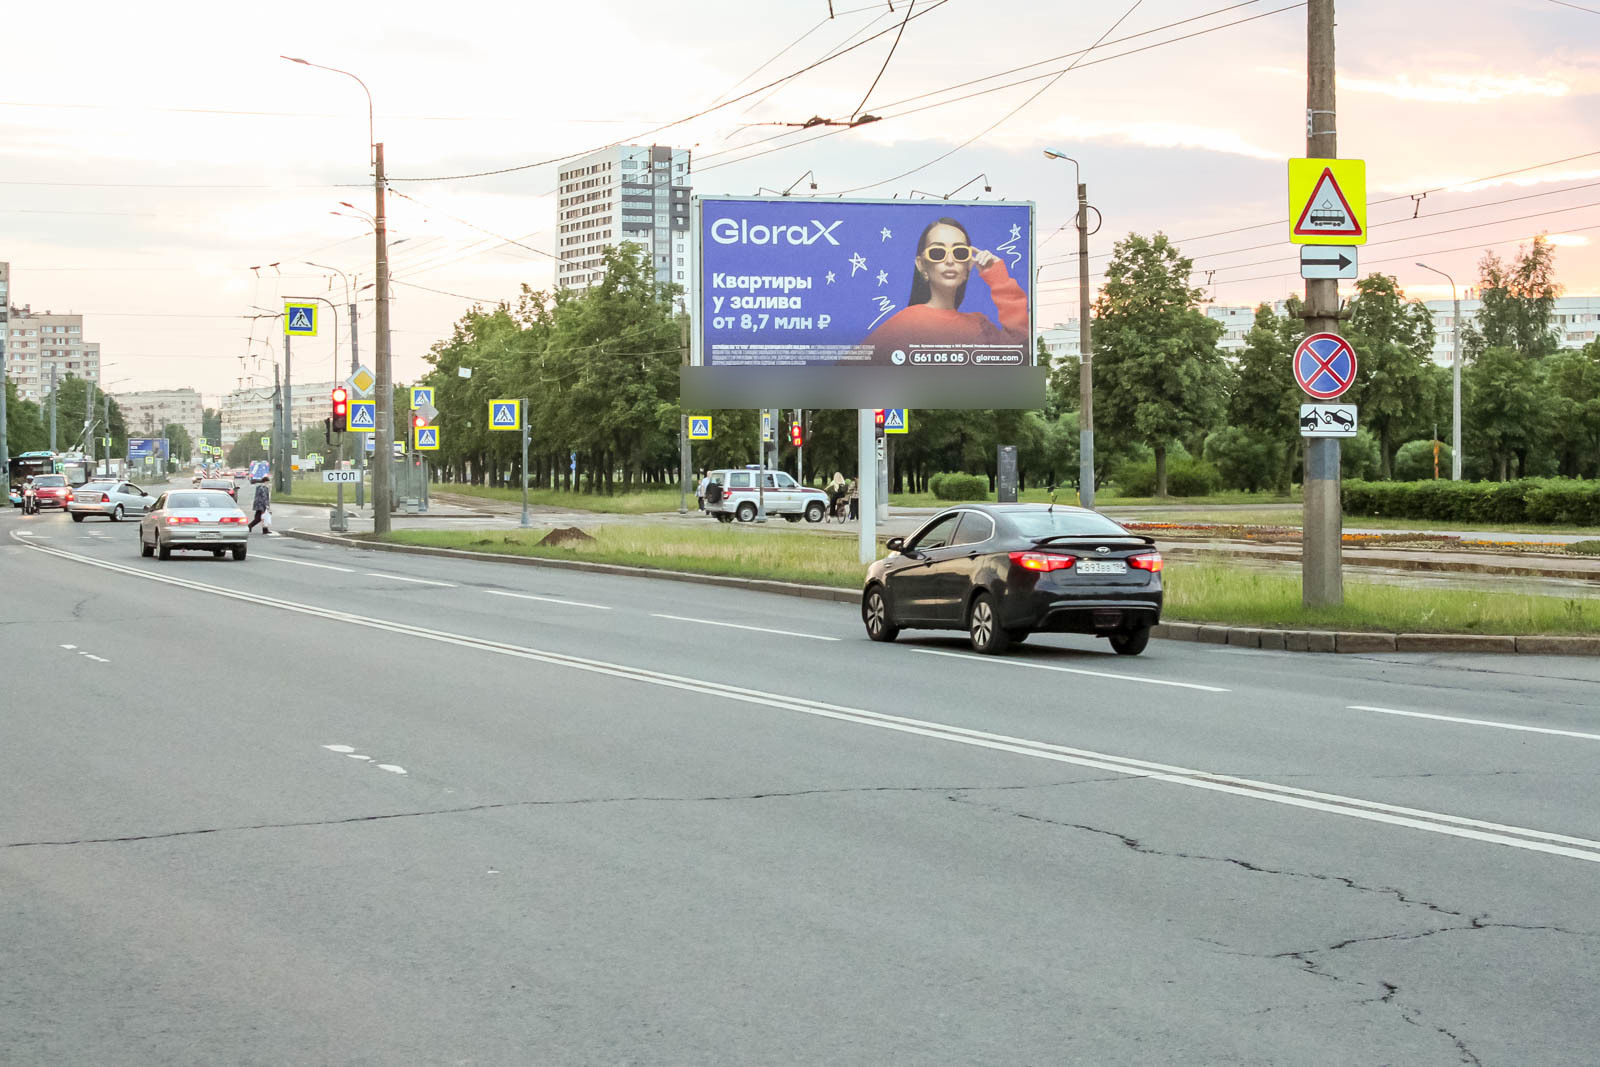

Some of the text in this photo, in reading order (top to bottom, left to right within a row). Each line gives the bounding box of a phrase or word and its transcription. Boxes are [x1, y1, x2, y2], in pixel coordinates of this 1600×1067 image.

[711, 218, 843, 245] GloraX
[713, 273, 812, 293] Квартиры
[712, 296, 801, 313] у залива
[713, 317, 735, 329] от
[740, 314, 770, 332] 8,7
[774, 317, 812, 329] млн
[914, 353, 964, 362] 561 05 05
[976, 353, 1019, 363] glorax.com
[327, 472, 355, 481] СТОП
